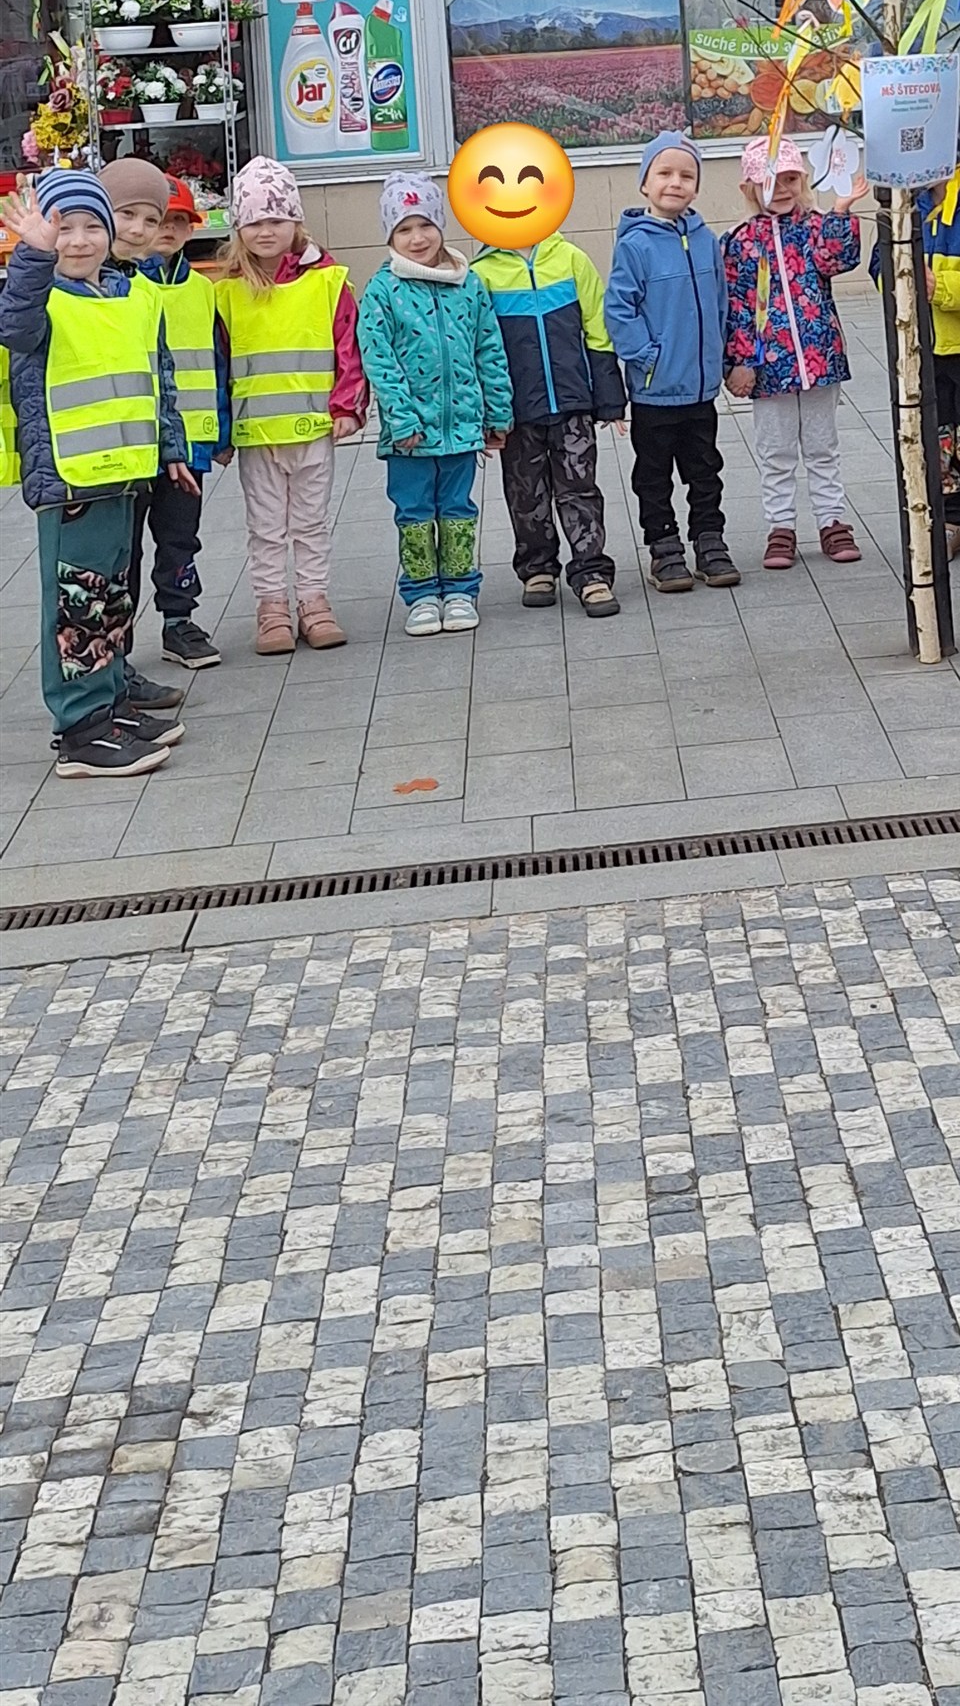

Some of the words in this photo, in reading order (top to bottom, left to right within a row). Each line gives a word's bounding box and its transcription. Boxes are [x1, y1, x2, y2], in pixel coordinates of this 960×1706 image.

[339, 32, 357, 53] Cif
[694, 33, 737, 51] suché
[881, 83, 895, 96] MŠ
